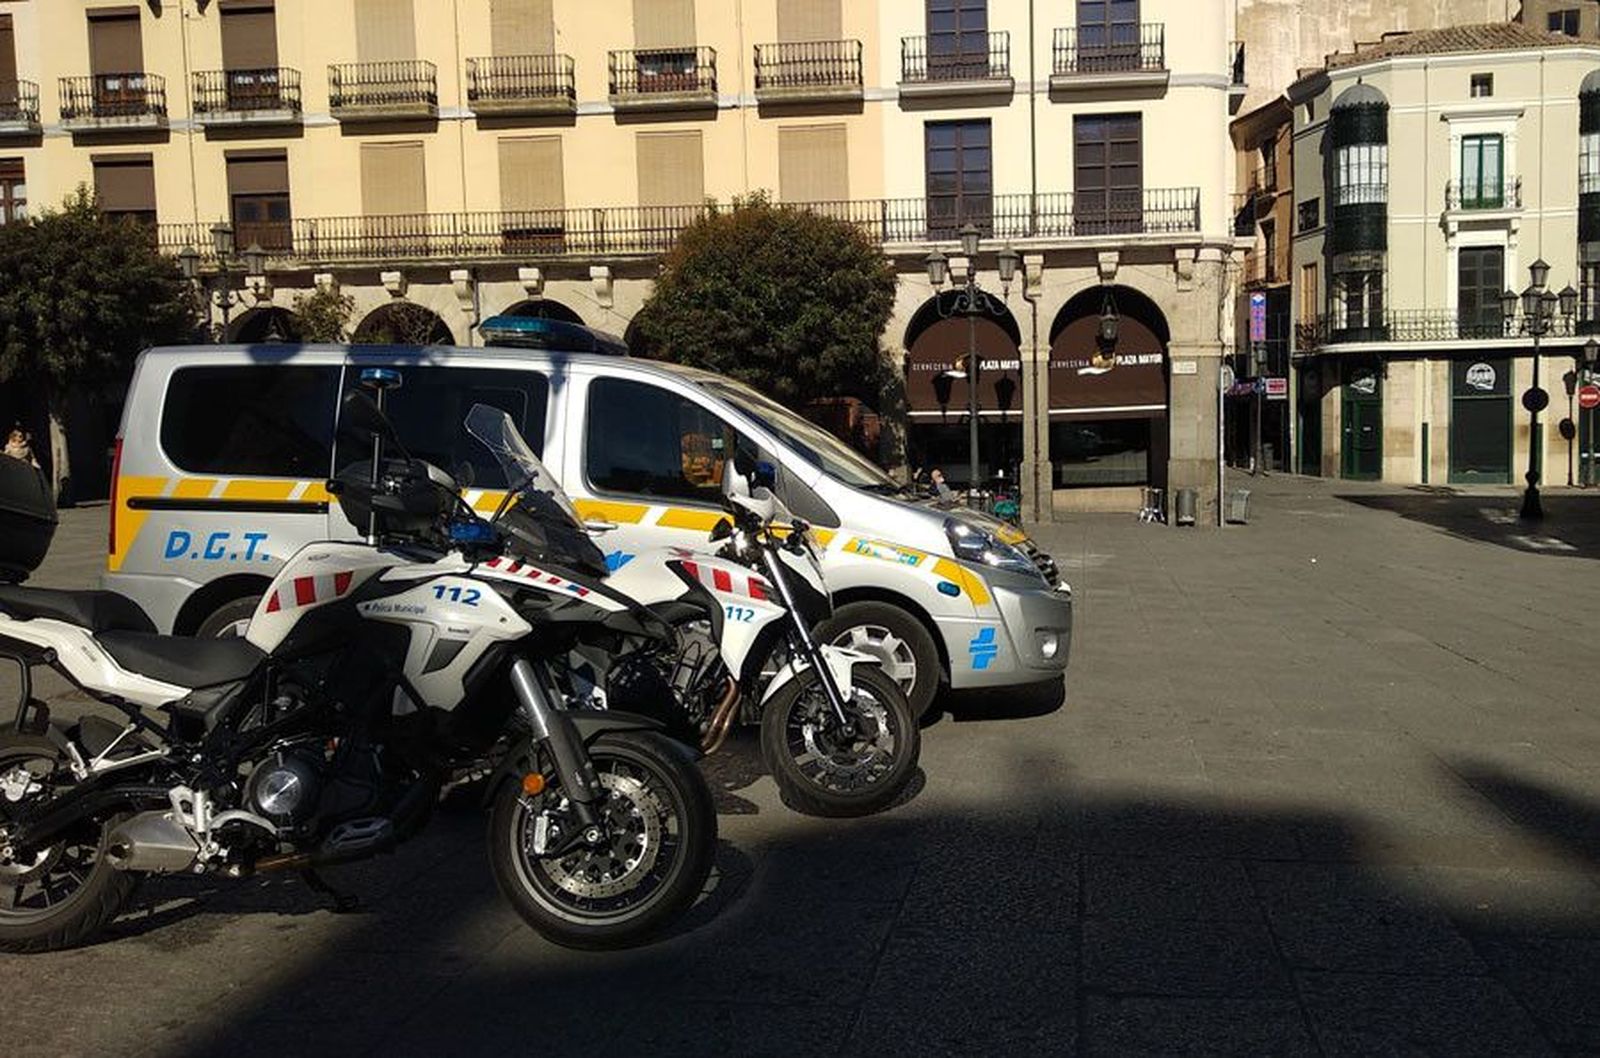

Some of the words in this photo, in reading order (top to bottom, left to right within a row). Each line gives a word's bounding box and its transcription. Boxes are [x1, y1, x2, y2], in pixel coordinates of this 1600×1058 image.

[980, 360, 999, 370] PLAZA
[1000, 360, 1020, 370] MAYO
[1116, 354, 1137, 365] PLAZA
[1139, 353, 1163, 364] MAYOR
[164, 531, 270, 561] D.G.T.
[432, 584, 481, 607] 112
[725, 606, 755, 623] 112
